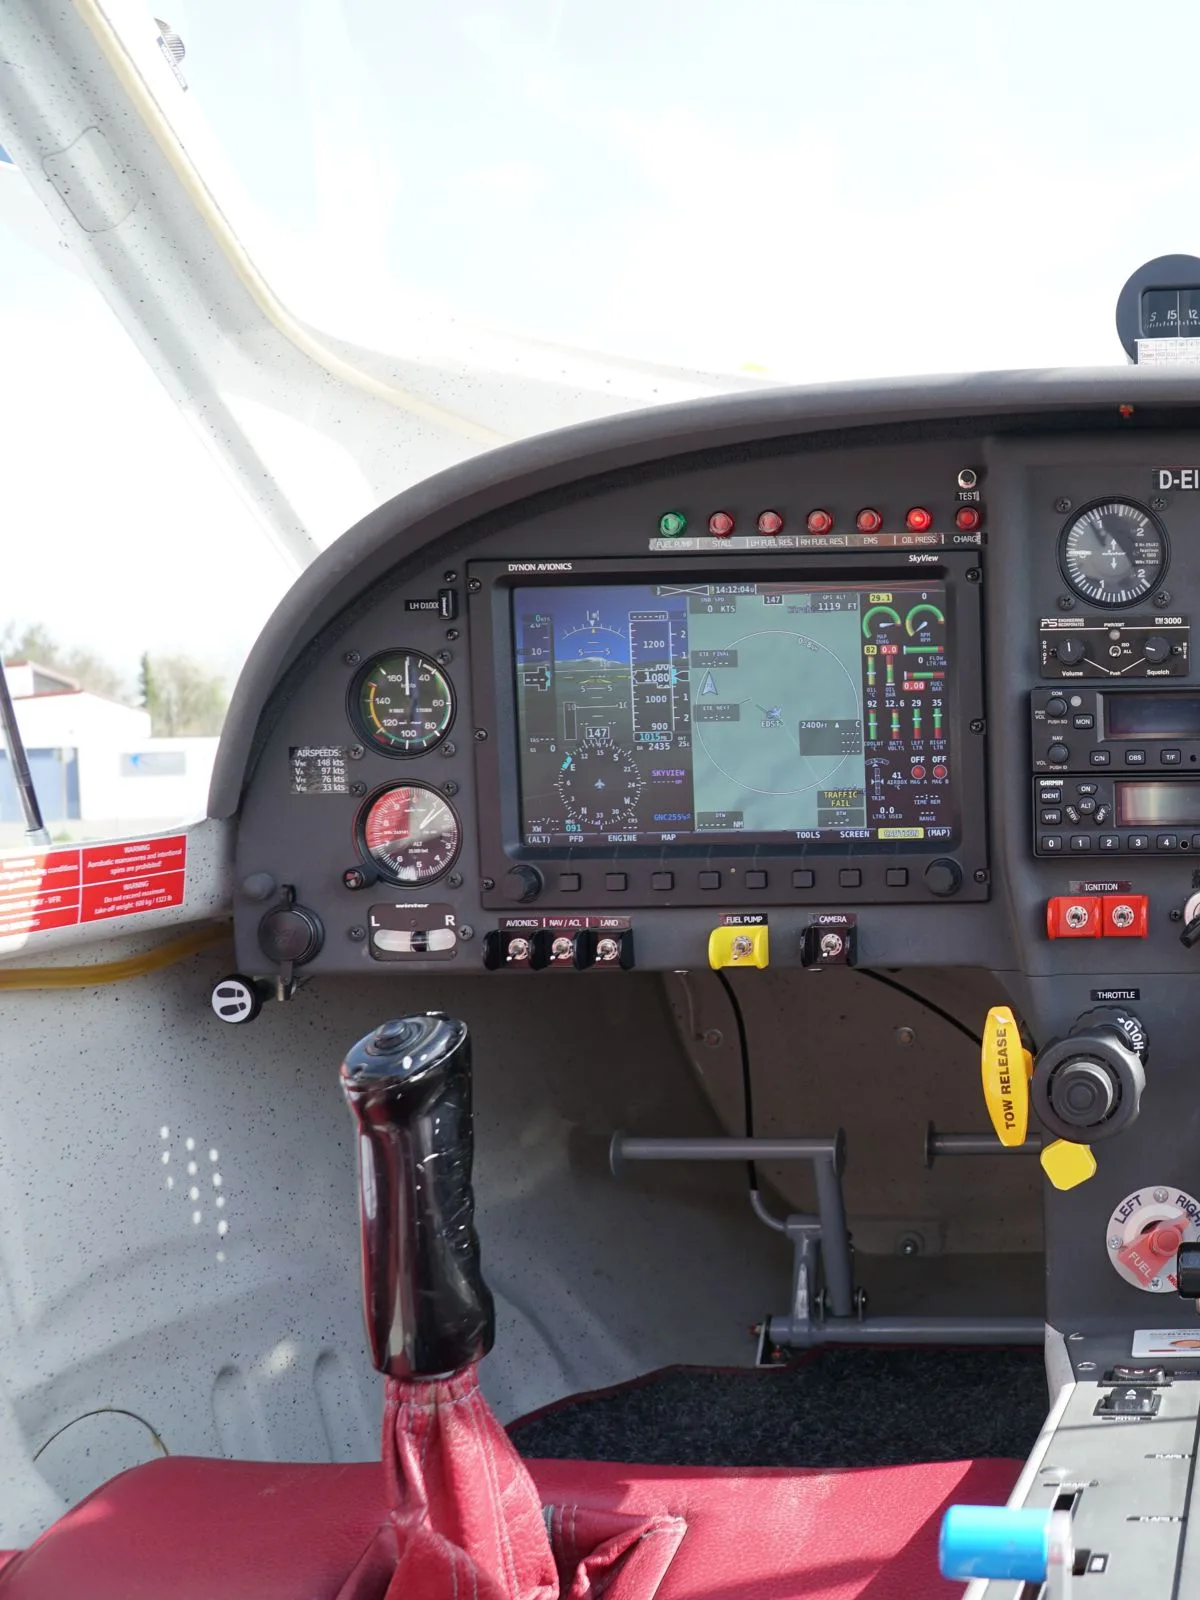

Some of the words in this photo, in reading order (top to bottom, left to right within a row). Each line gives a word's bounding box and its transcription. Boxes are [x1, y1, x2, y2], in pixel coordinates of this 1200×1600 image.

[1167, 310, 1177, 320] 15
[1188, 309, 1199, 319] 12
[958, 492, 976, 500] TEST
[913, 536, 938, 544] PRESS.
[909, 554, 939, 563] SkyView
[508, 563, 537, 572] DYNON
[538, 562, 572, 571] AVIONICS
[375, 697, 390, 705] 140
[383, 719, 398, 727] 120
[588, 729, 606, 737] 147
[298, 749, 341, 757] AIRSPEEDS:
[317, 759, 331, 767] 148
[332, 758, 344, 767] kts
[321, 767, 331, 775] 97
[332, 767, 344, 775] kts
[322, 775, 331, 783] 76
[332, 775, 344, 783] kts
[332, 783, 344, 791] kts
[927, 829, 950, 837] (MAP)
[1085, 883, 1118, 891] IGNITION
[371, 916, 380, 927] L
[445, 914, 456, 926] R
[549, 919, 562, 927] NAV
[568, 919, 581, 927] ACL
[600, 919, 618, 927] LAND
[726, 916, 742, 924] FUEL
[743, 915, 763, 924] PUMP
[819, 915, 847, 923] CAMERA
[506, 919, 538, 928] AVIONICS
[1097, 991, 1135, 999] THROTTLE
[1124, 1020, 1144, 1052] HOLD
[1000, 1028, 1012, 1100] RELEASE
[1005, 1104, 1015, 1130] TOW
[1114, 1194, 1143, 1224] LEFT
[1128, 1251, 1152, 1278] FUEL
